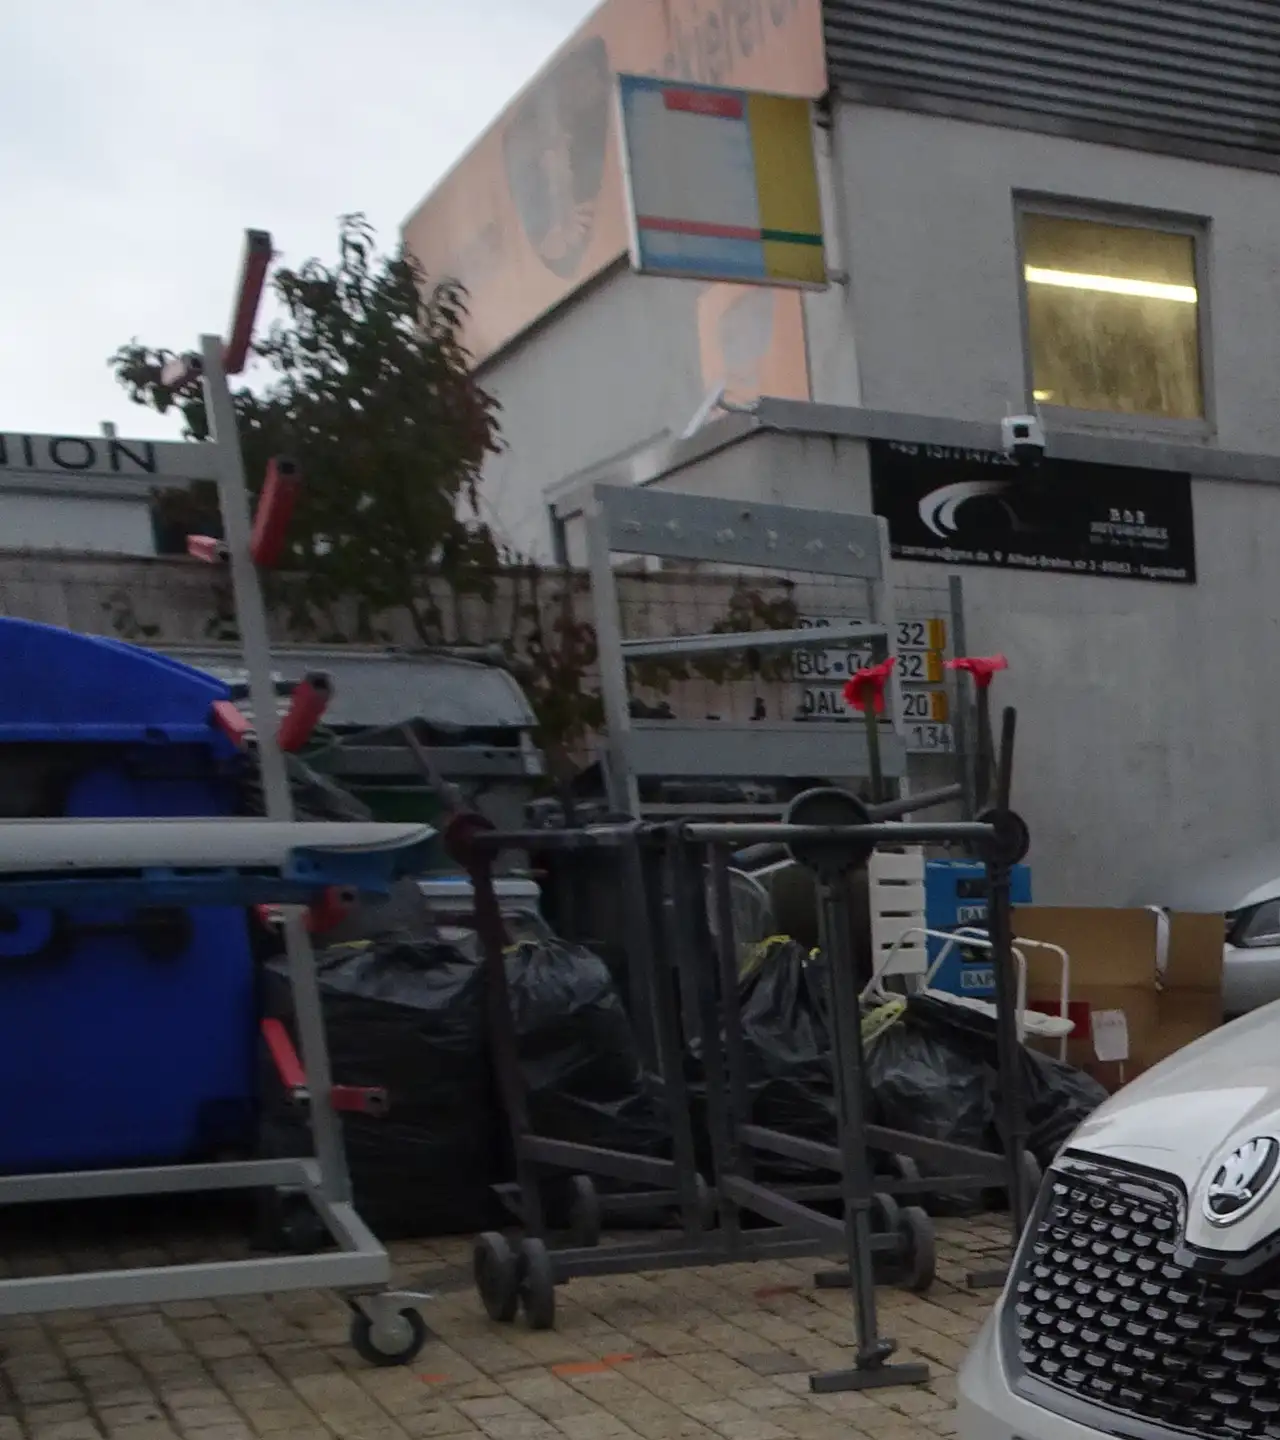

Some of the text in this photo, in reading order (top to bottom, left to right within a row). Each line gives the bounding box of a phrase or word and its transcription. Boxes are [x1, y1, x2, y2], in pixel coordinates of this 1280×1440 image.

[897, 622, 926, 645] 32
[796, 651, 830, 675] BC
[897, 654, 925, 677] 32
[903, 693, 928, 717] 20
